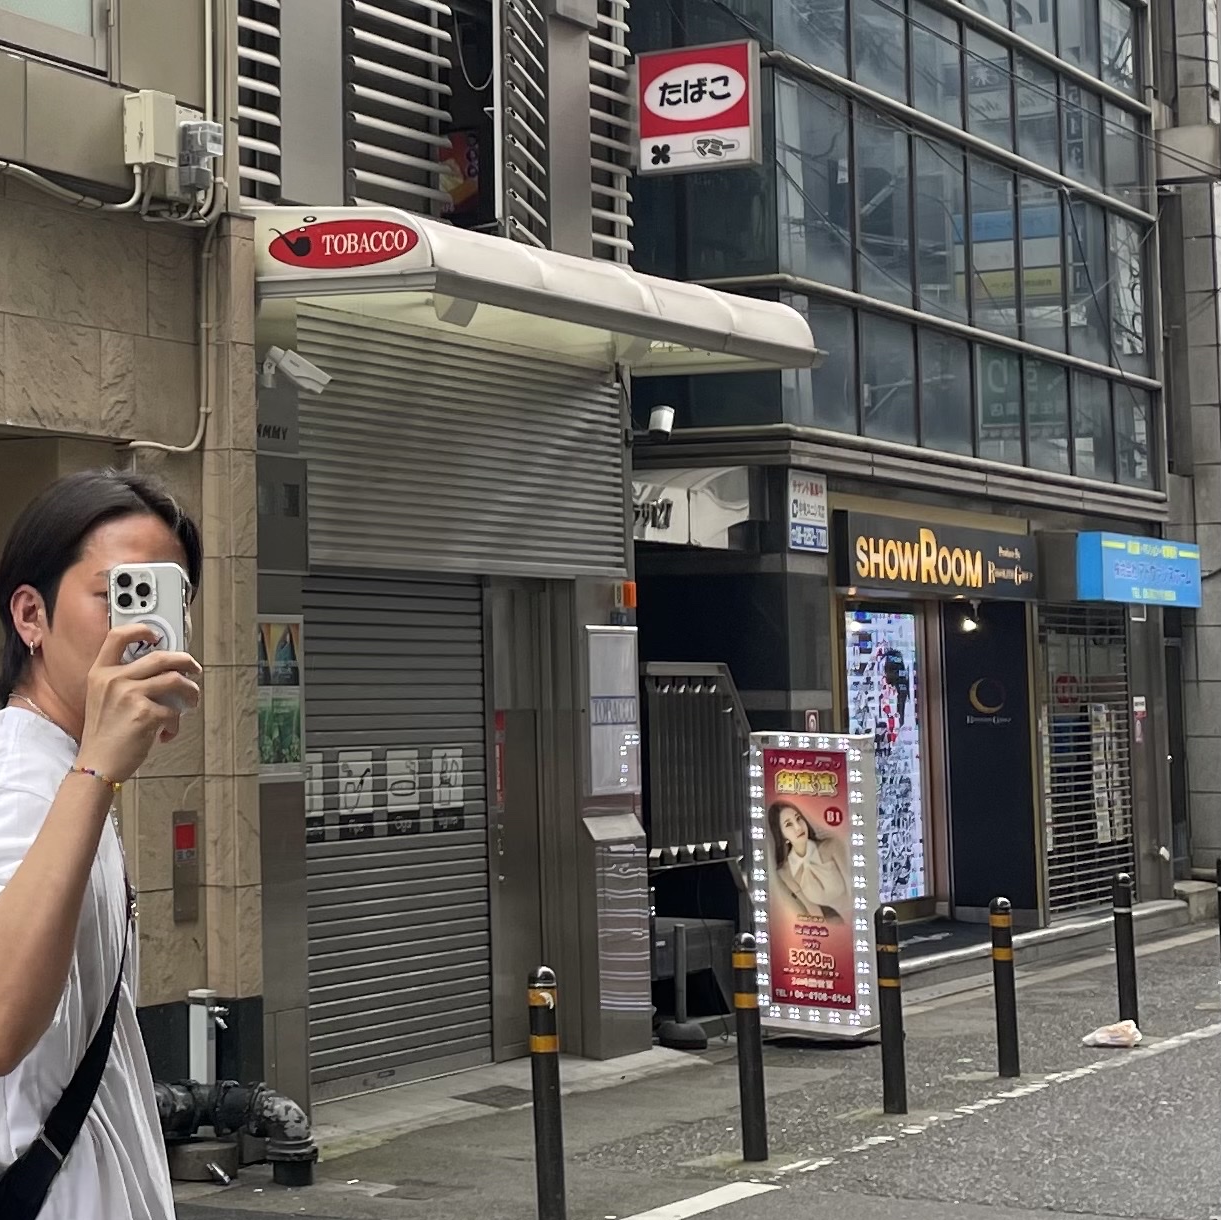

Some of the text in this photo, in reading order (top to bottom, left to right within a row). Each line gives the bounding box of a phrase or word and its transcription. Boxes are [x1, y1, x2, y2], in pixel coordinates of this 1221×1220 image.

[658, 75, 732, 107] たばこ
[696, 138, 735, 156] マミー
[321, 229, 408, 256] TOBACCO
[826, 810, 840, 823] B1
[789, 949, 835, 968] 3000円
